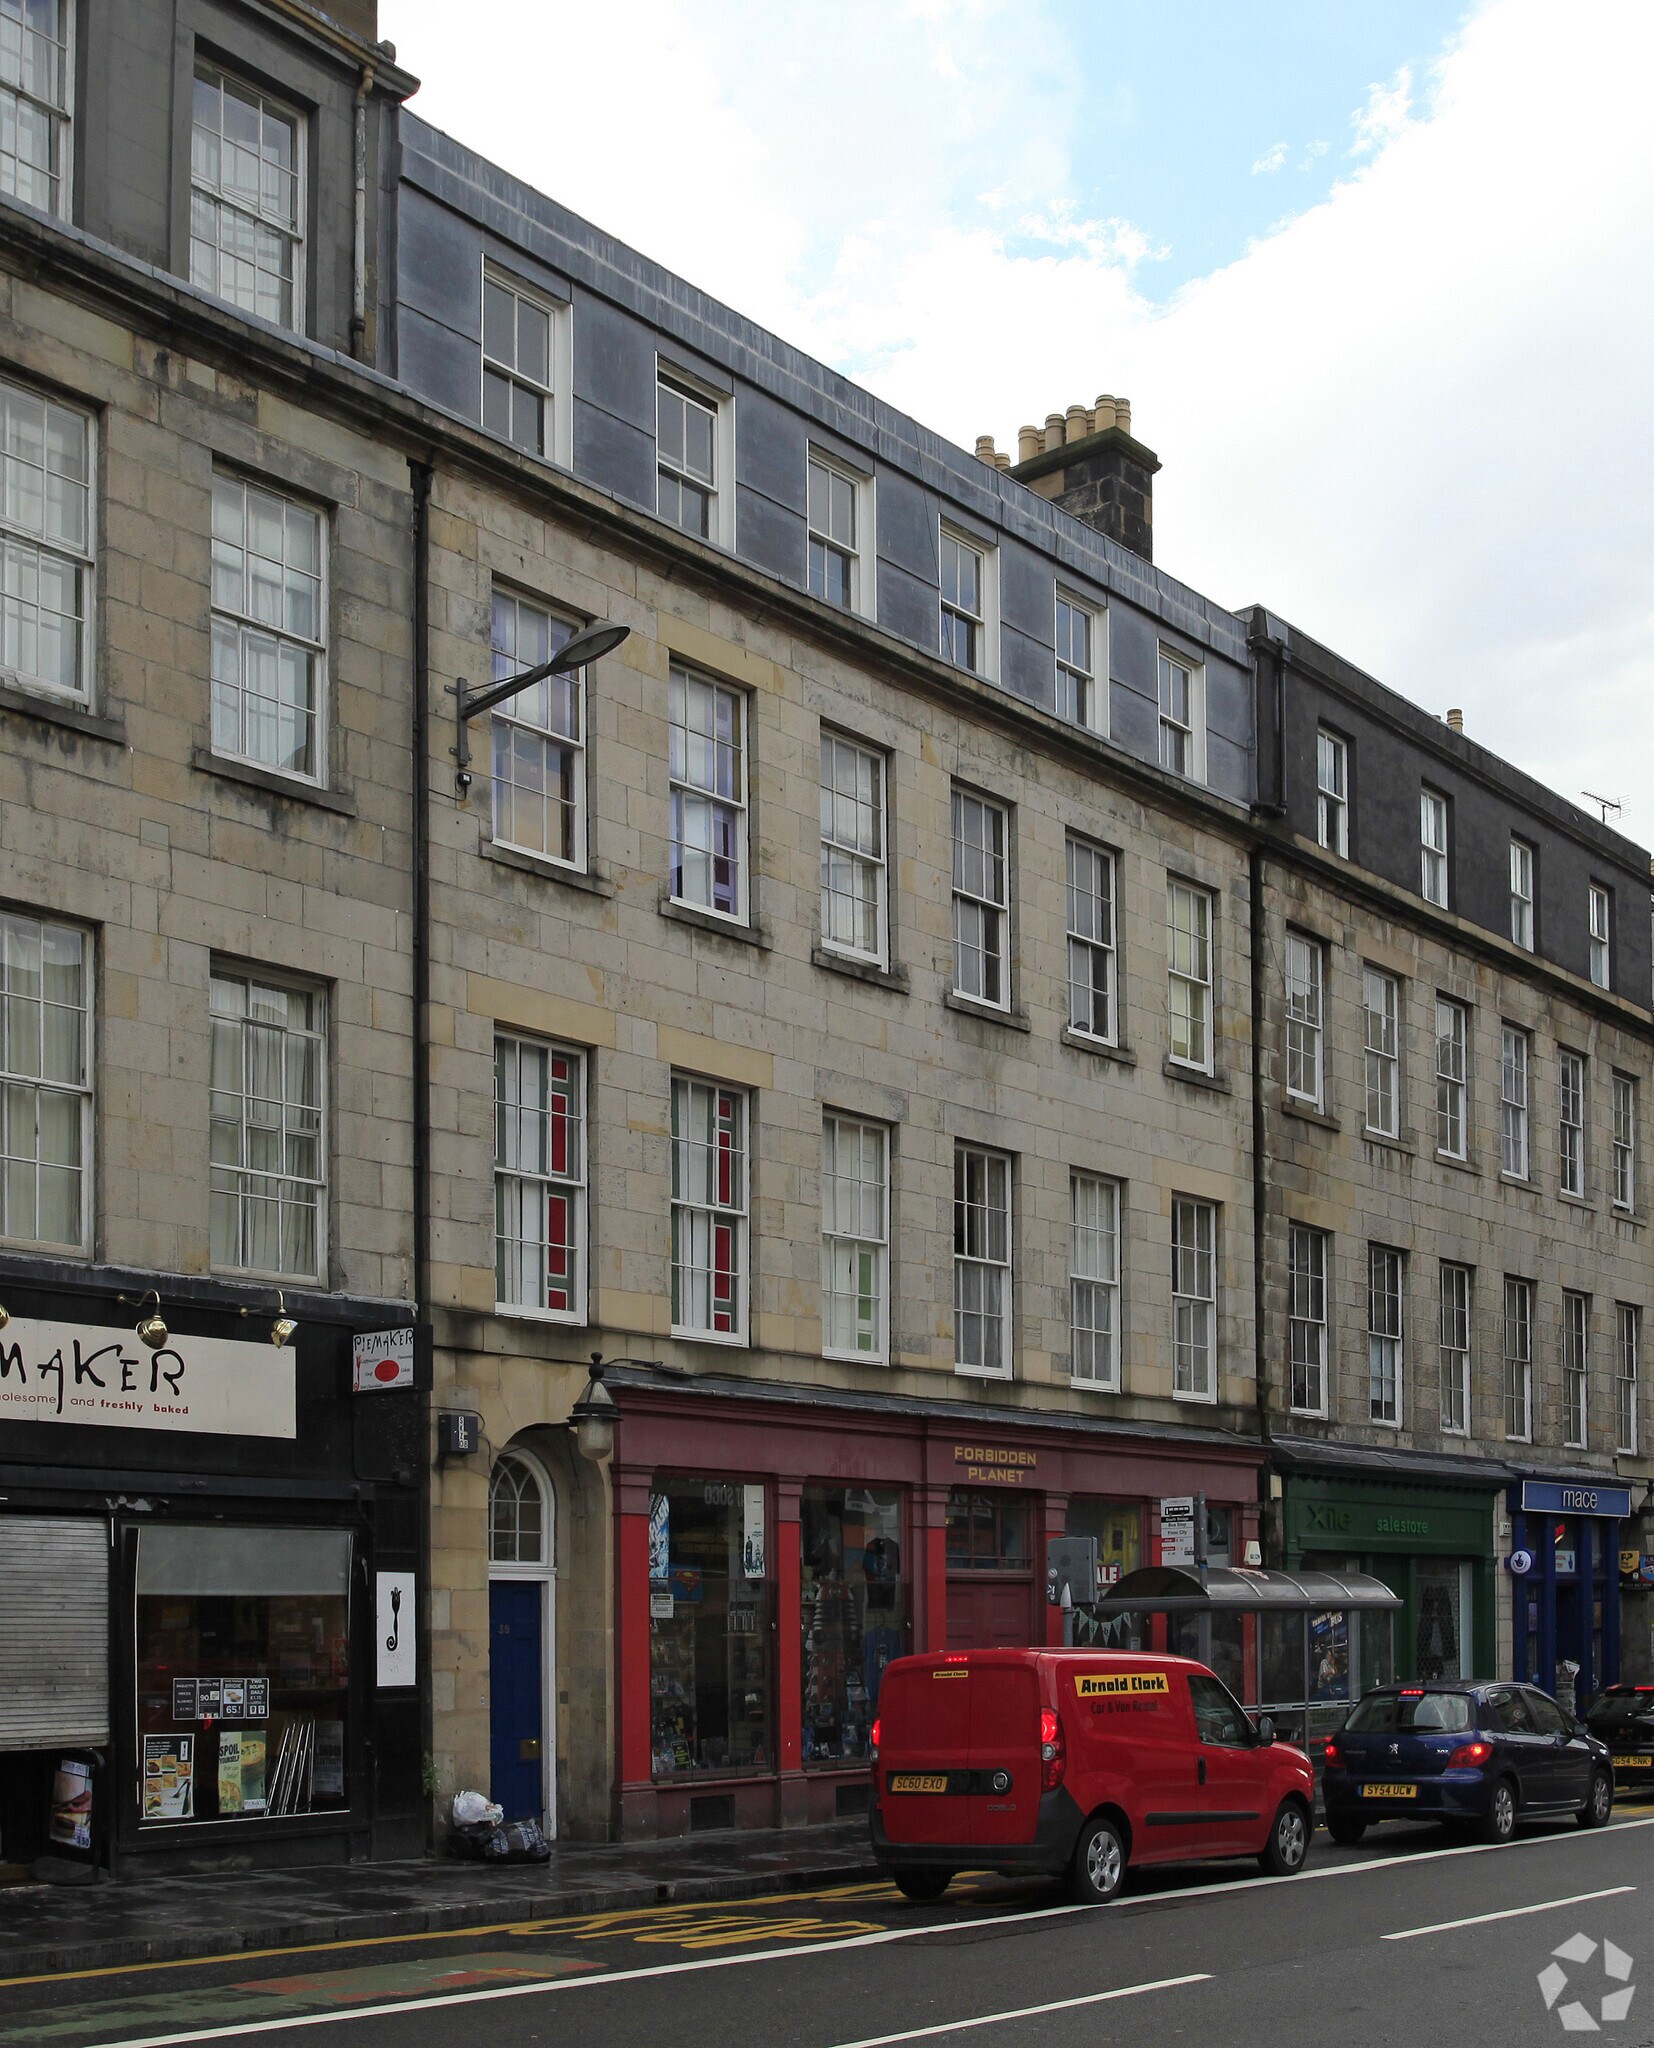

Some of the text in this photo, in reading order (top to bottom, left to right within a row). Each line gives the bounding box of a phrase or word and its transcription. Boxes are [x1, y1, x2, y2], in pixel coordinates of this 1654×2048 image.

[0, 1393, 189, 1414] olesome and freshly baked
[954, 1446, 1037, 1466] FORBIDDEN
[968, 1467, 1024, 1483] PLANET
[1562, 1490, 1598, 1509] mace
[1081, 1676, 1165, 1693] Arnold Clark
[1090, 1699, 1158, 1714] Car & Van Rental
[220, 1743, 240, 1757] SPOIL
[897, 1777, 921, 1790] SC60
[1367, 1785, 1413, 1796] SY54 UCW
